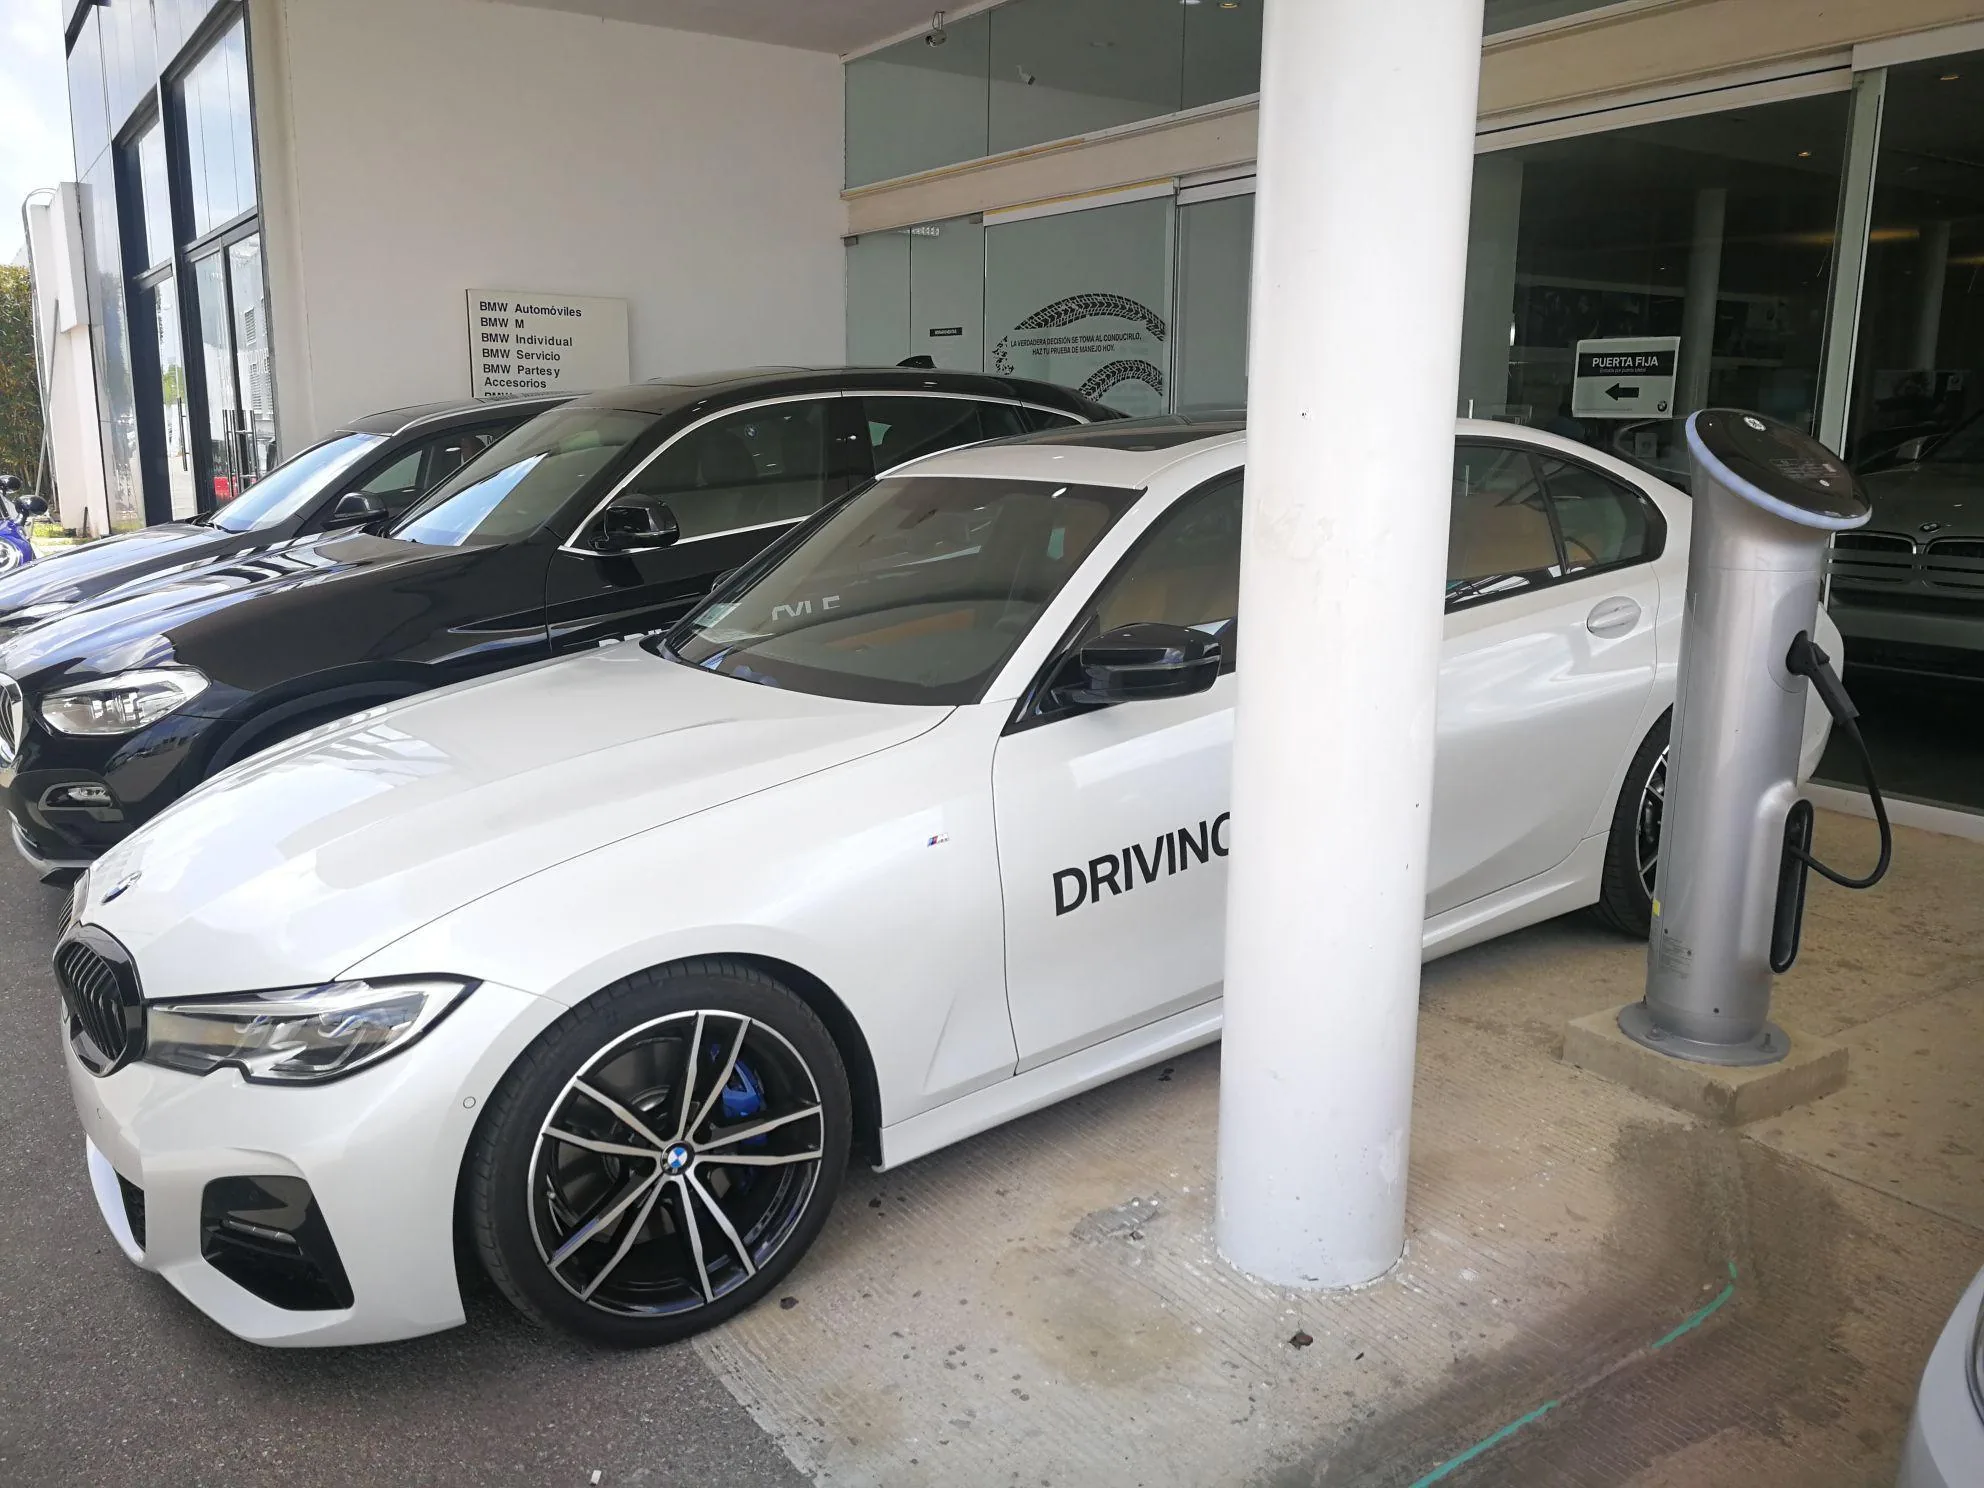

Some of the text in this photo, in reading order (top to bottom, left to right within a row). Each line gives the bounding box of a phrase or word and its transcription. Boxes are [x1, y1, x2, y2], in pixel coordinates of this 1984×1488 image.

[479, 301, 582, 317] BMW Automóviles
[480, 317, 525, 329] BMW M
[481, 333, 573, 347] BMW Individual
[1018, 338, 1047, 346] VERDADERA
[1079, 335, 1095, 343] TOMA
[1095, 334, 1103, 342] AL
[482, 348, 561, 361] BMW Servicio
[1032, 347, 1043, 355] HAZ
[1043, 347, 1050, 355] TU
[1050, 346, 1071, 354] PRUEBA
[1079, 344, 1102, 352] MANEJO
[1592, 356, 1659, 368] PUERTA FIJA
[483, 364, 560, 379] BMW Partes y
[484, 377, 547, 389] Accesorios
